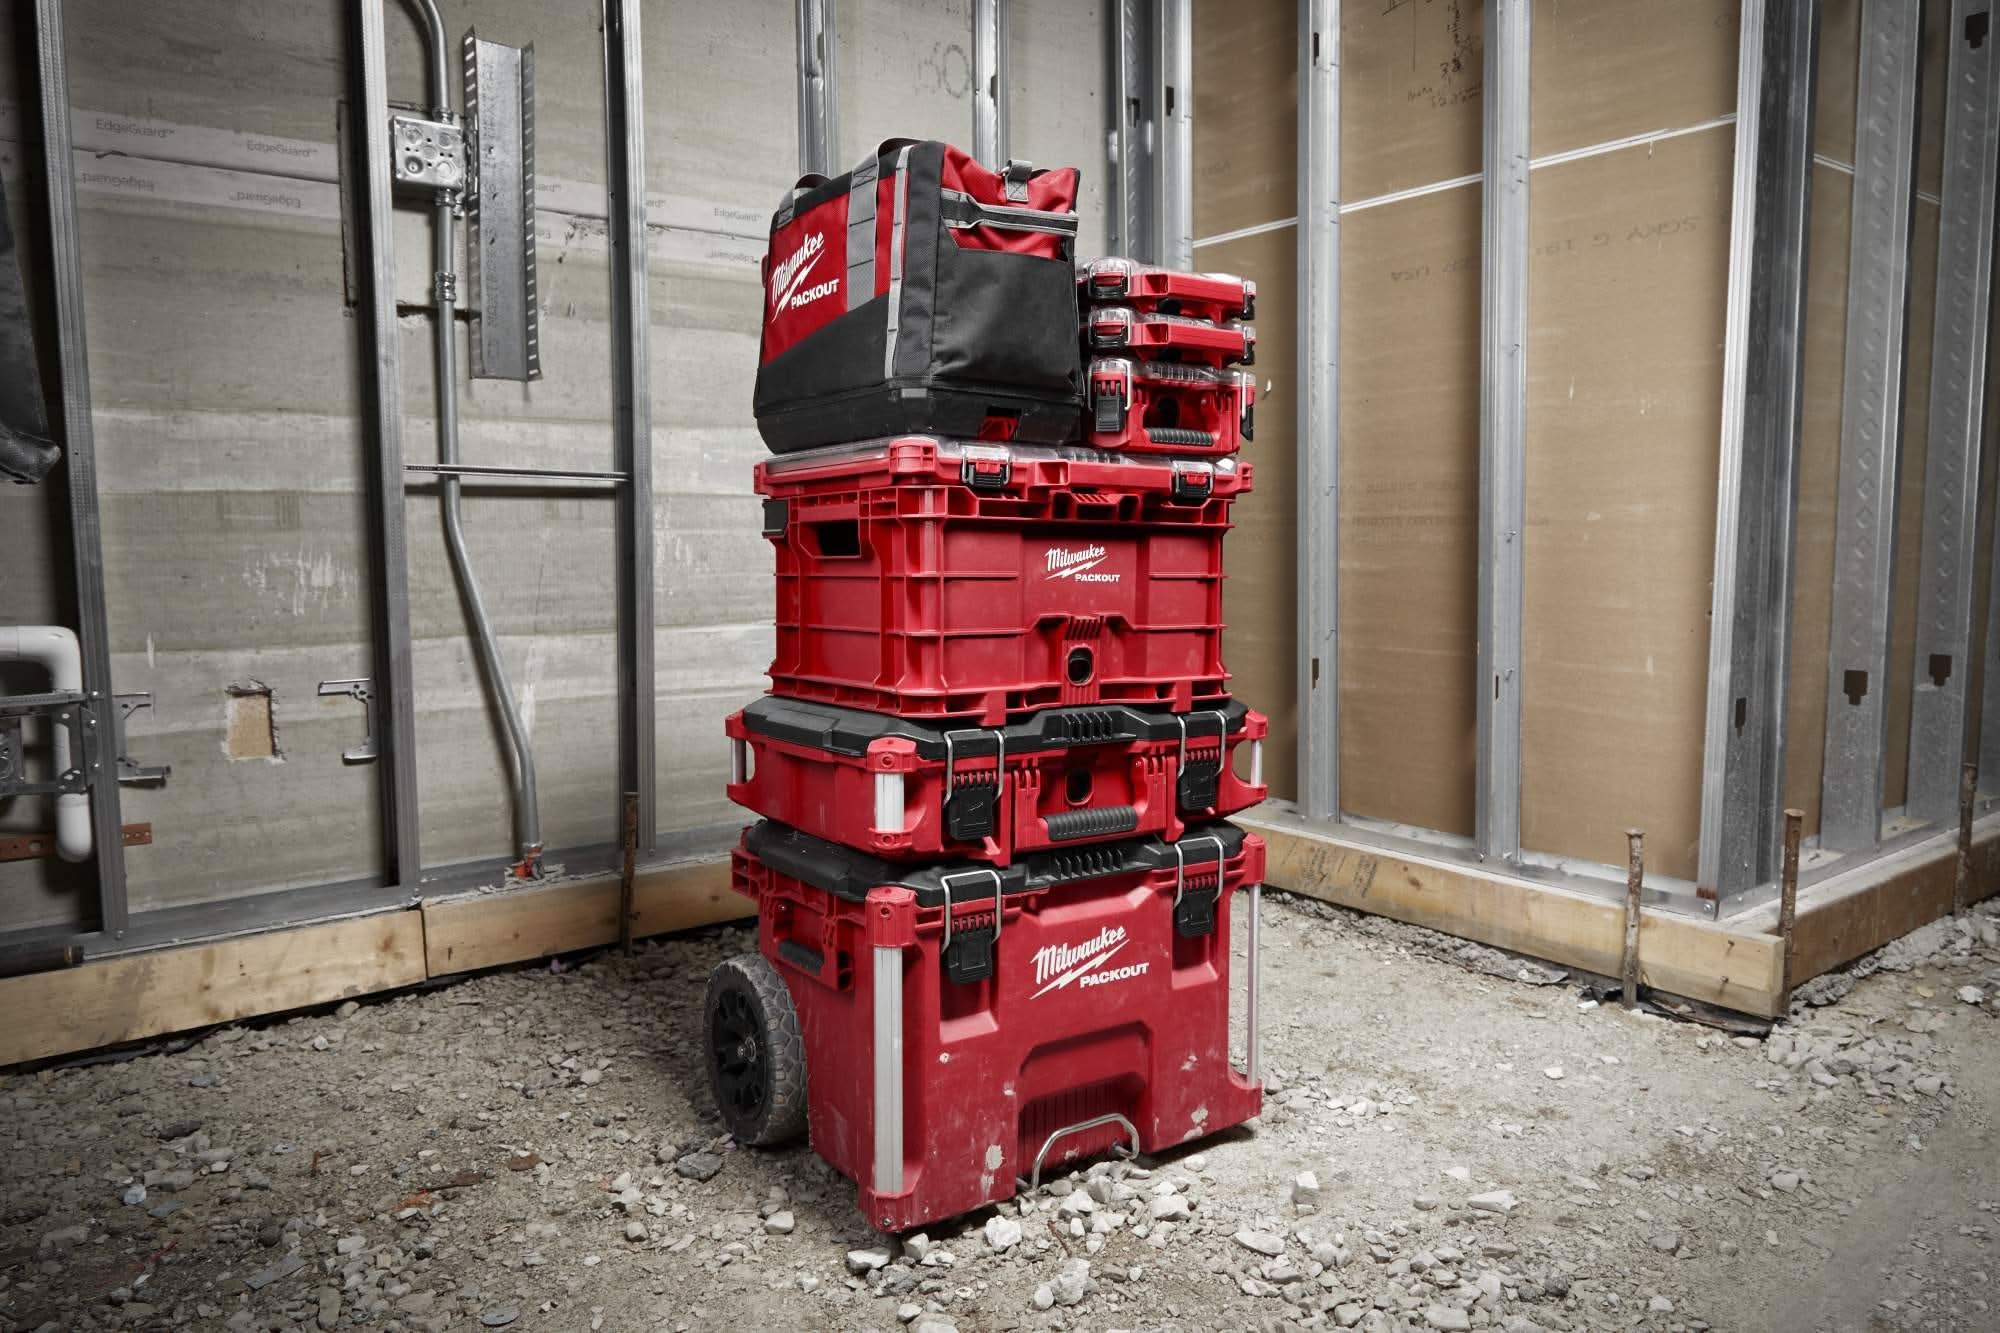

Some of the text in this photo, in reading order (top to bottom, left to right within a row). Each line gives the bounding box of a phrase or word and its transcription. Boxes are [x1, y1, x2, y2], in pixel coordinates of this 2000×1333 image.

[771, 231, 824, 307] Milwaukee
[791, 278, 840, 310] PACKOUT
[1044, 543, 1106, 572] Milwaukee
[1075, 573, 1121, 583] PACKOUT
[1030, 926, 1126, 985] Milwaukee
[1080, 962, 1149, 988] PACKOUT
